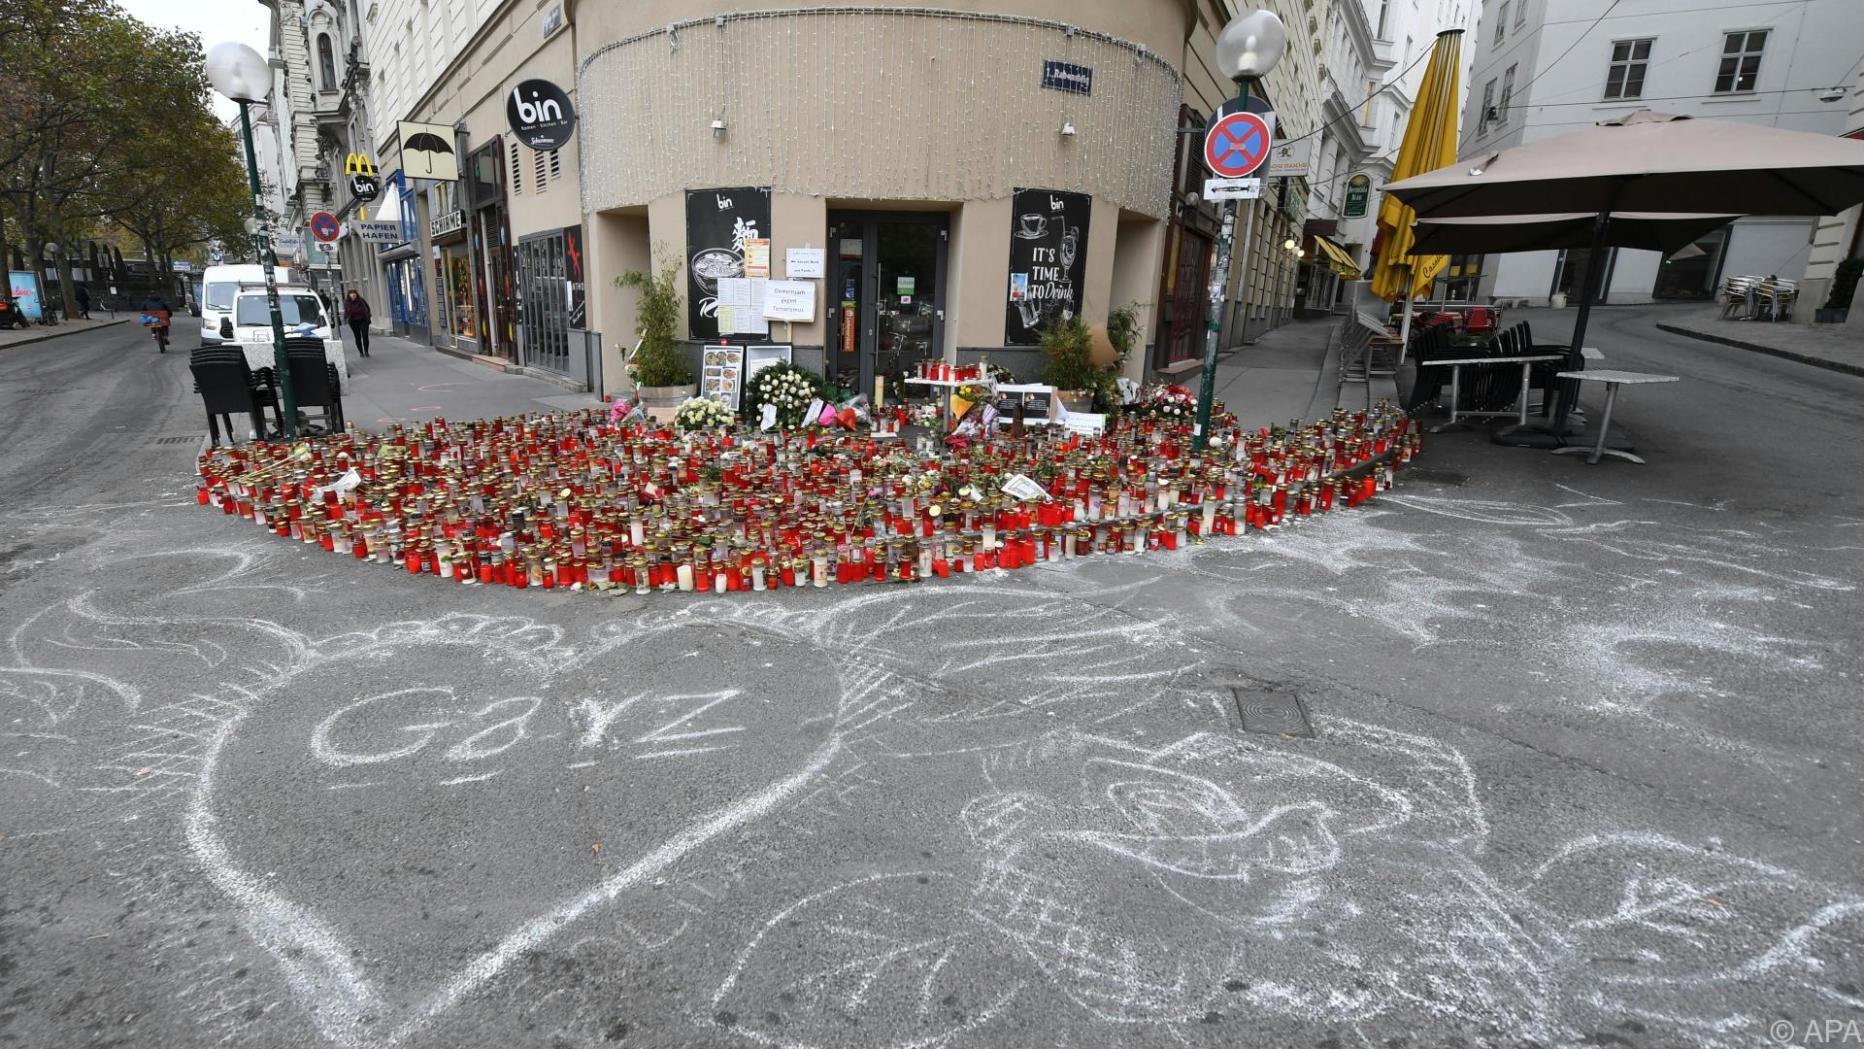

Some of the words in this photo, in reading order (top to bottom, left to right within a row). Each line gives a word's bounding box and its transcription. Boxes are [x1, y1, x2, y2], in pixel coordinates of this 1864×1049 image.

[513, 86, 562, 123] bin
[353, 178, 374, 192] bin
[716, 193, 733, 209] bin
[1050, 194, 1065, 210] bin
[360, 223, 396, 231] PAPIER
[431, 212, 461, 236] SCHIRME
[1032, 247, 1056, 262] IT'S
[1032, 266, 1060, 281] TIME
[1031, 284, 1045, 299] TO
[1045, 281, 1074, 300] Drink
